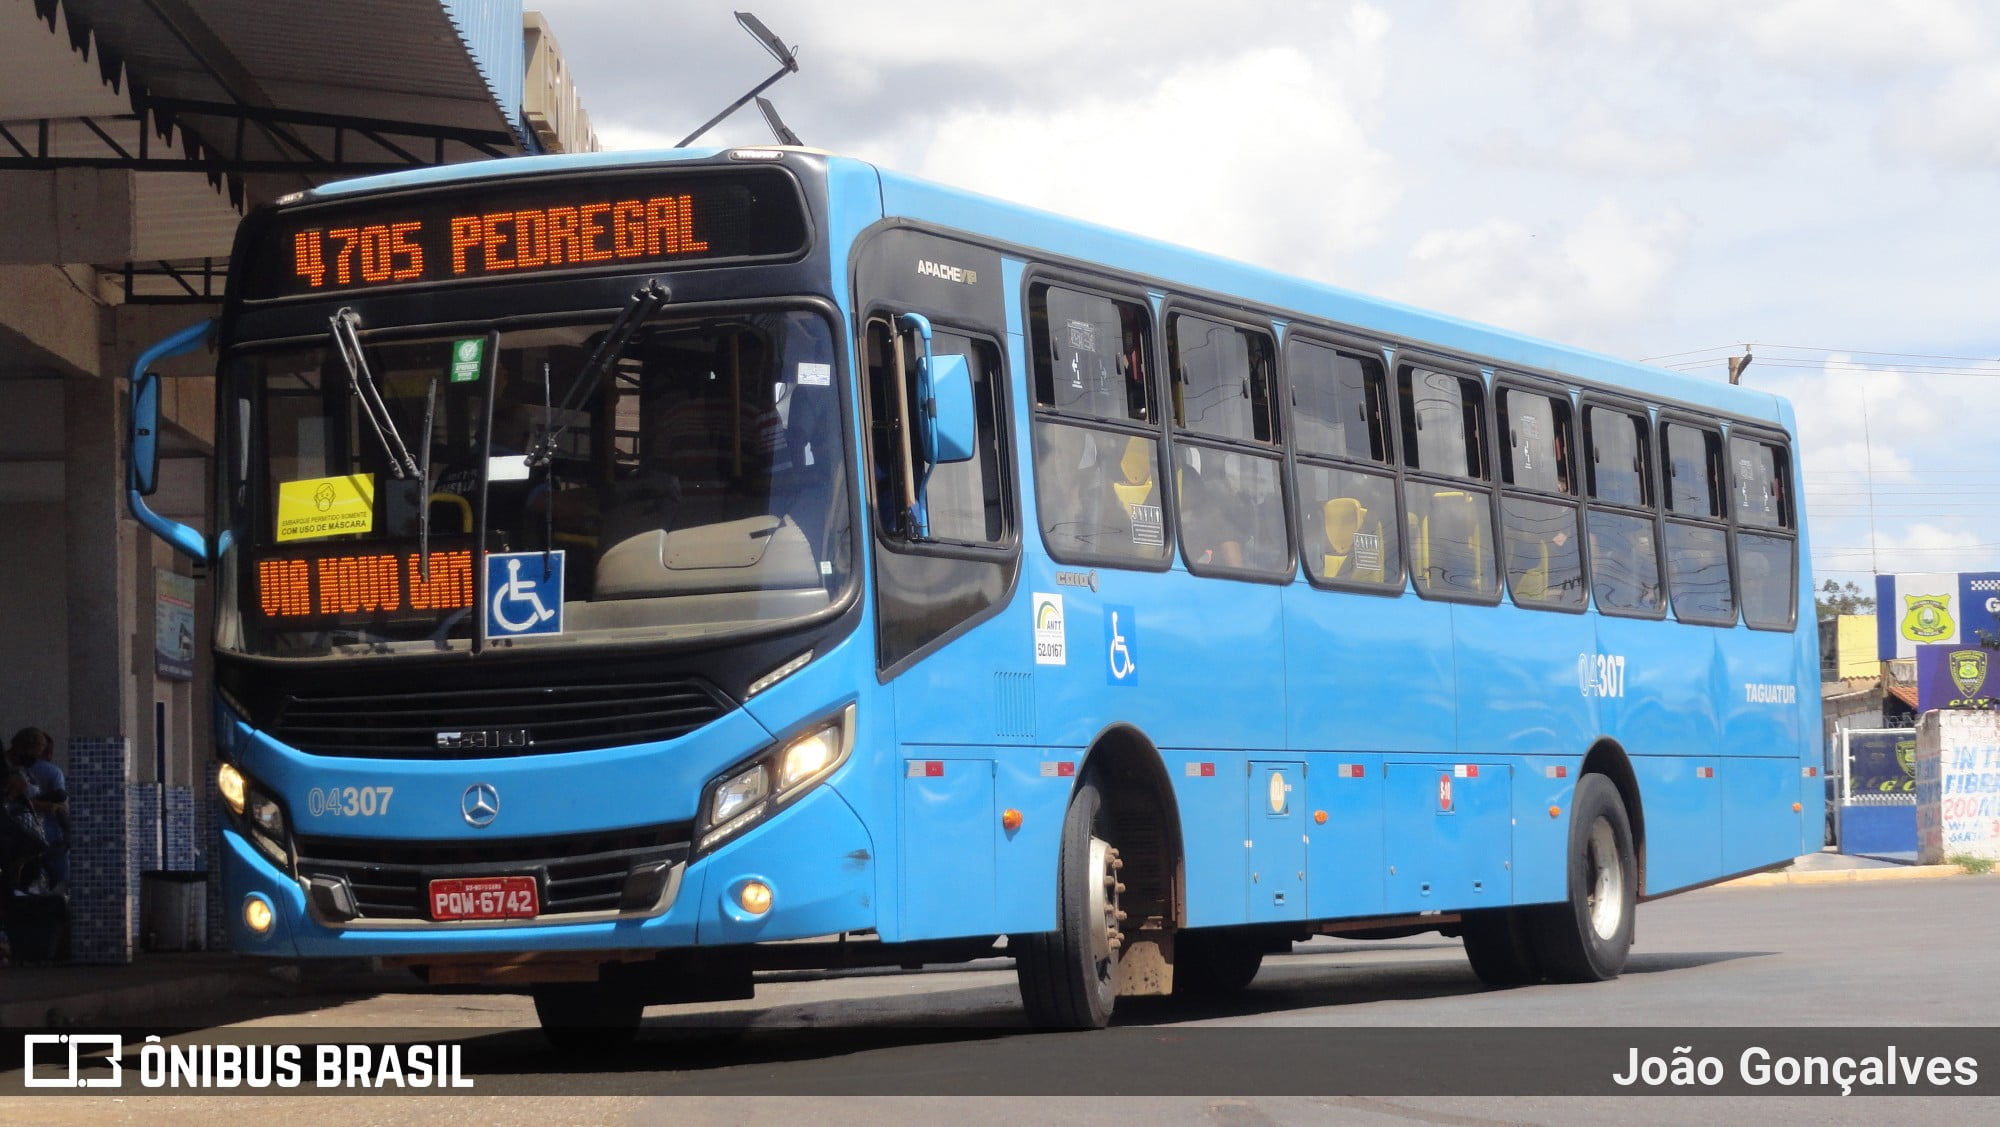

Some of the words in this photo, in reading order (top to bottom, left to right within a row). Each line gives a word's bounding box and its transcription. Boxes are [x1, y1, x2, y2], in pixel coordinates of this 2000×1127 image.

[295, 221, 423, 287] 4705
[450, 194, 709, 275] PEDREGAL
[282, 518, 310, 526] EMBARQUE
[299, 526, 315, 534] USO
[328, 520, 366, 529] MÁSCARA
[318, 554, 400, 614] NOVO
[1046, 620, 1061, 630] ANTT
[1037, 643, 1063, 657] 52.0167
[1578, 653, 1625, 698] 04307
[1744, 683, 1796, 704] TAGUATUR
[308, 786, 394, 817] 04307
